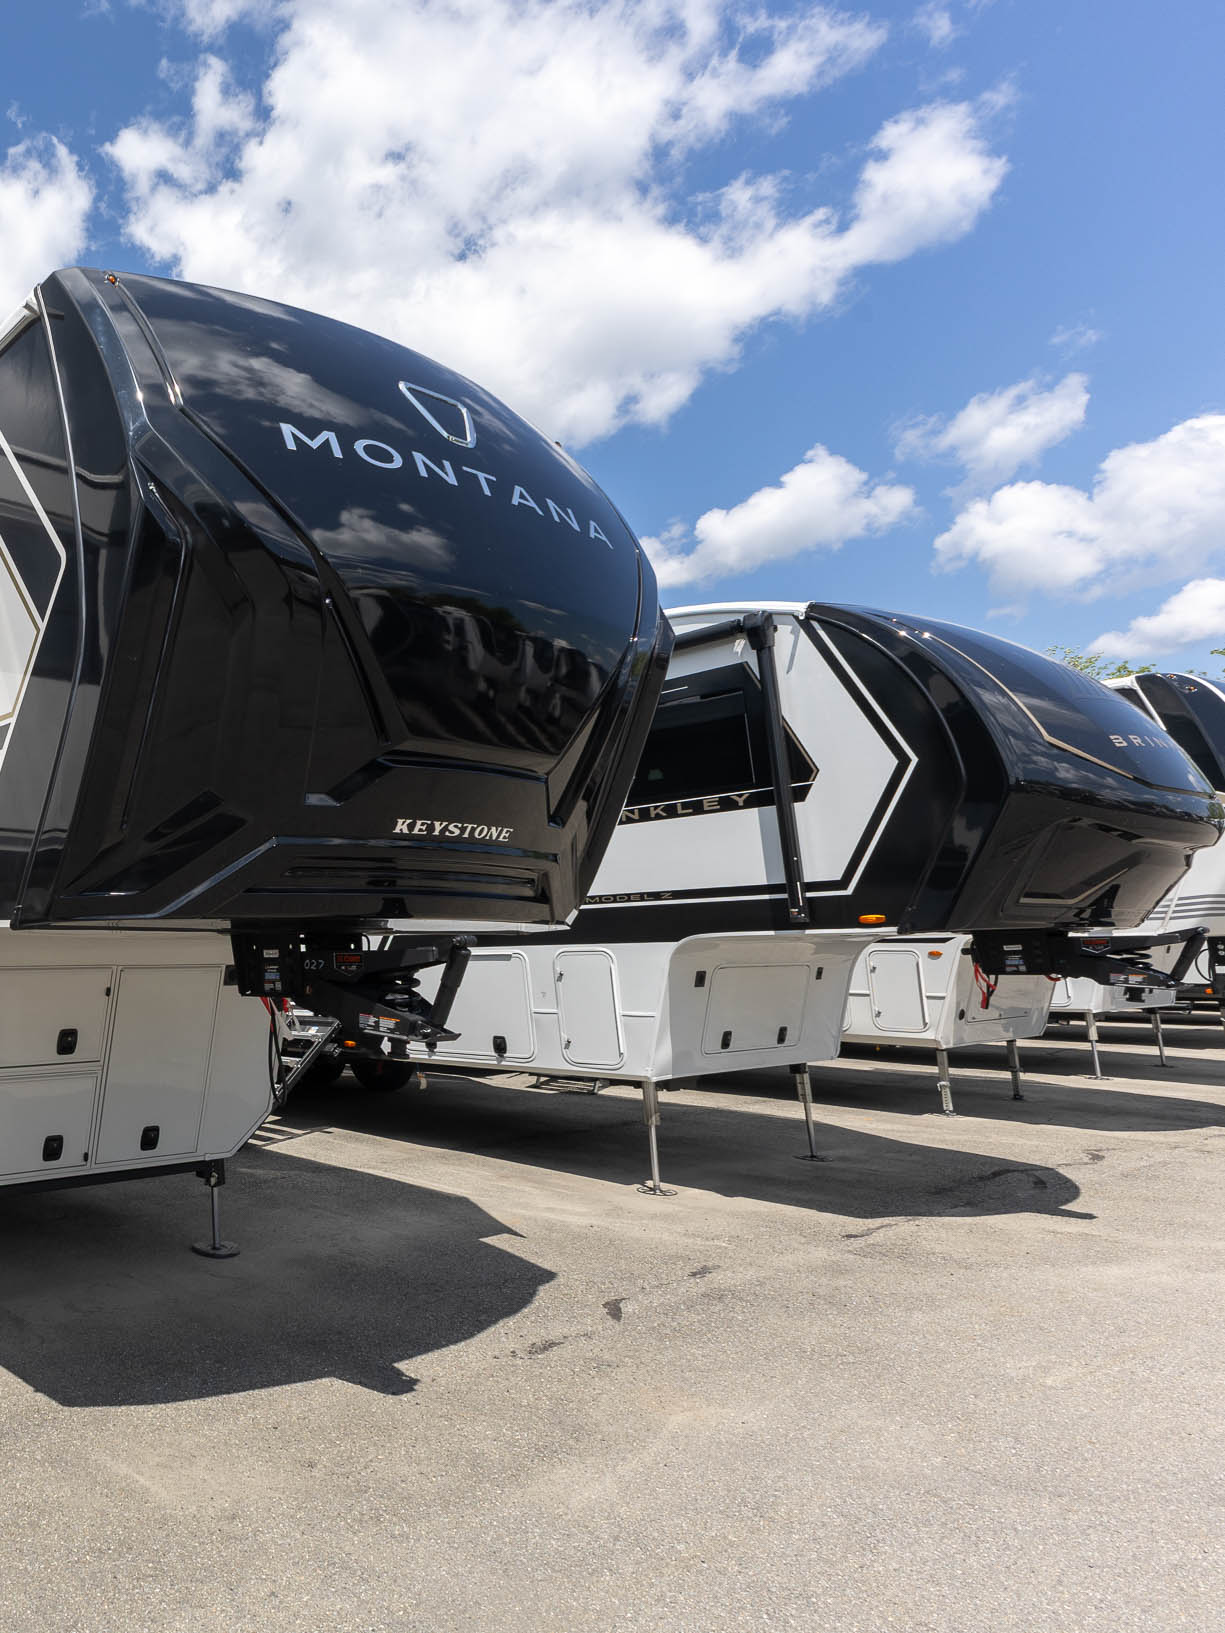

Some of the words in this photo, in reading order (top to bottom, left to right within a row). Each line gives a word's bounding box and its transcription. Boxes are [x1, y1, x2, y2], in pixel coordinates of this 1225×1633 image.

[279, 422, 614, 550] MONTANA
[621, 793, 751, 822] NKLEY
[392, 818, 514, 842] KEYSTONE
[585, 893, 655, 904] MODEL
[659, 892, 673, 900] Z
[303, 959, 325, 970] 027
